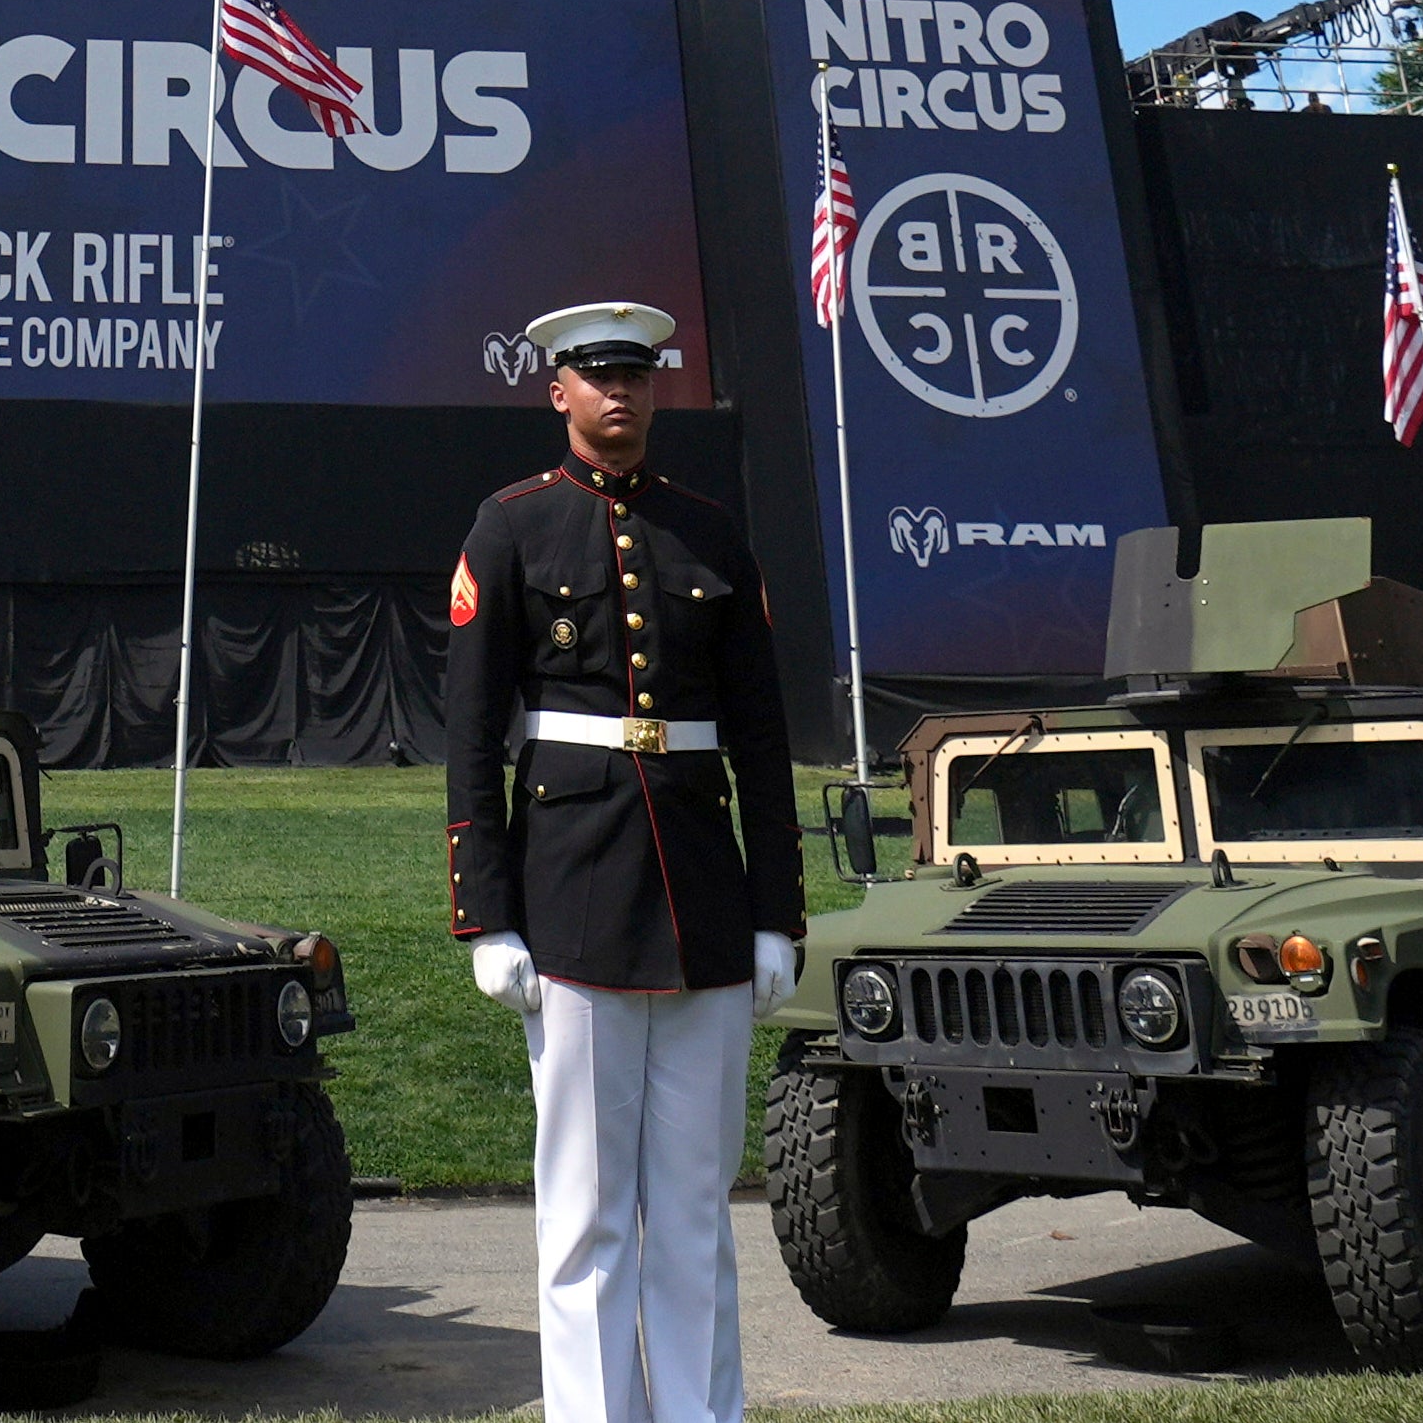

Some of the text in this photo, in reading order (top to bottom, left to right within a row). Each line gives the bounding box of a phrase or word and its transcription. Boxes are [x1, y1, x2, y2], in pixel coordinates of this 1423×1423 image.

[810, 65, 1067, 133] CIRCUS
[72, 232, 225, 306] RIFLE
[21, 316, 224, 370] COMPANY
[956, 522, 1107, 548] RAM
